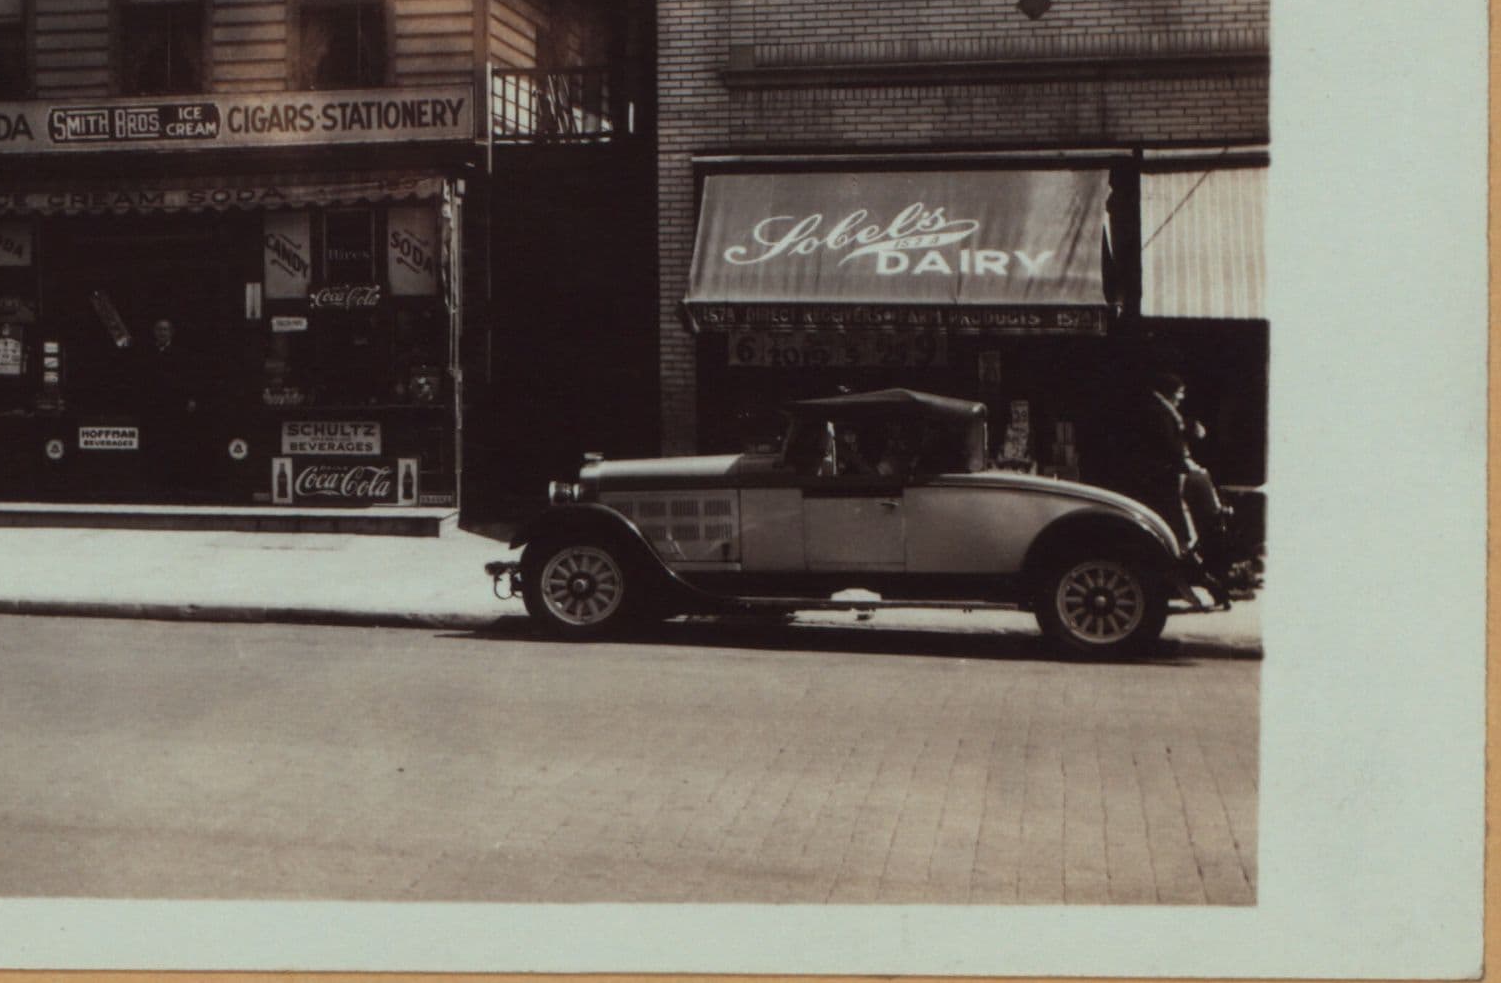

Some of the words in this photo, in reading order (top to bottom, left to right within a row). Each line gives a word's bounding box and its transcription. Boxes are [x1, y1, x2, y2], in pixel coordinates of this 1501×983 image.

[177, 106, 202, 120] ICE
[227, 103, 315, 134] CIGARS
[321, 97, 466, 132] STATIONERY
[165, 121, 217, 137] CREAM
[48, 191, 164, 208] CREAM
[188, 187, 284, 204] SODA
[723, 202, 950, 265] Sobel's
[265, 233, 308, 279] CANDY
[390, 231, 433, 278] SODA
[875, 249, 1056, 276] DAIRY
[81, 430, 136, 439] HOFFMAN
[287, 424, 376, 437] SCHULTZ
[290, 442, 374, 452] BEVERAGES
